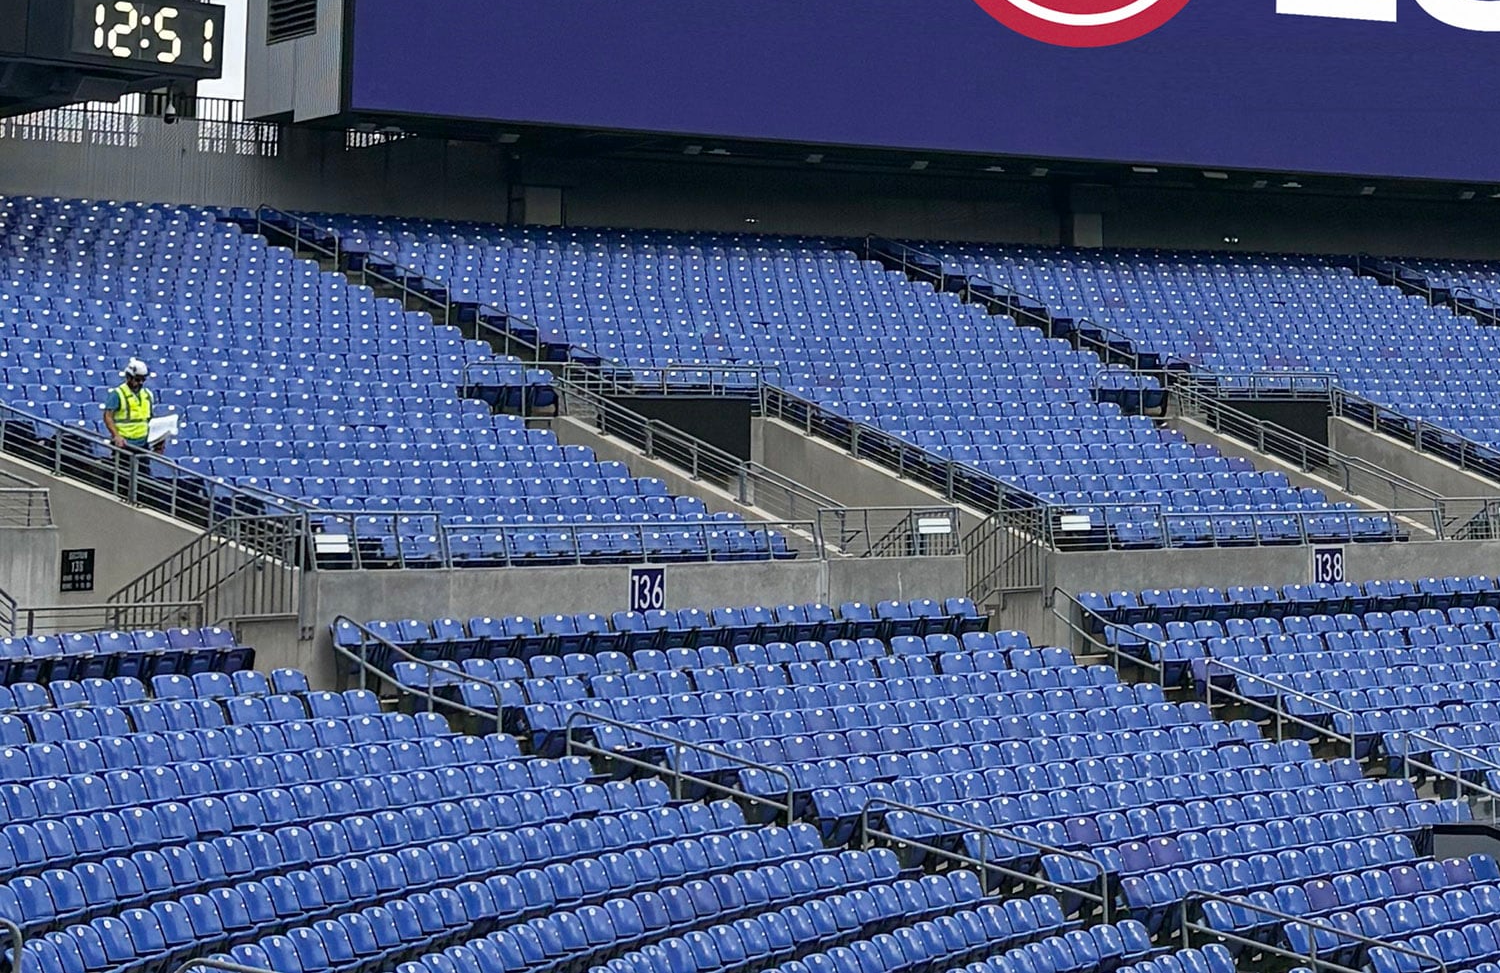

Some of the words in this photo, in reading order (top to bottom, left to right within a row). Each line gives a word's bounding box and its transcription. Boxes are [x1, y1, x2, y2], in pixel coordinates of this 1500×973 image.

[94, 1, 213, 63] 12:51
[1317, 550, 1344, 582] 138
[632, 574, 663, 609] 136
